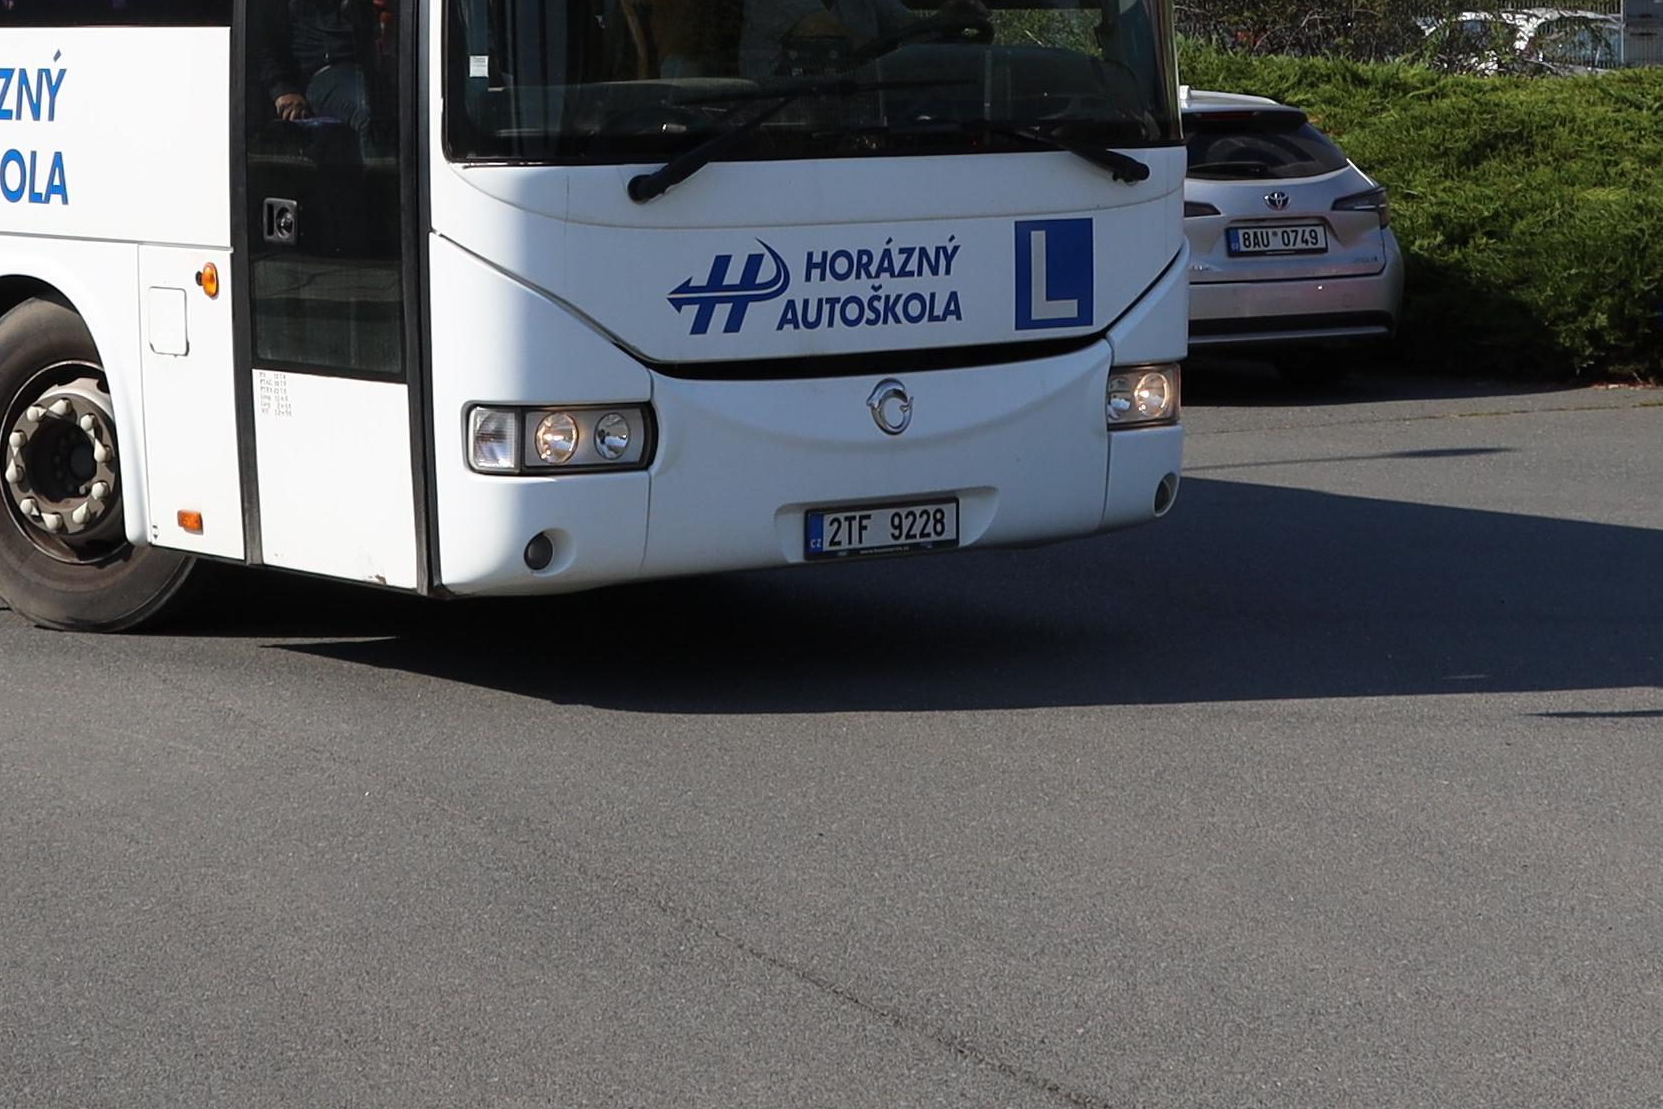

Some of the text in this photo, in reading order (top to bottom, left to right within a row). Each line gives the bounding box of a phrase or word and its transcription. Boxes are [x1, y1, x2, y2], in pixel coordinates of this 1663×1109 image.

[804, 234, 961, 282] HORÁZNÝ
[1242, 230, 1271, 249] 8AU
[1281, 228, 1320, 247] 0749
[1030, 229, 1078, 321] L
[776, 284, 963, 331] AUTOŠKOLA
[810, 538, 822, 548] CZ
[828, 507, 946, 547] 2TF 9228
